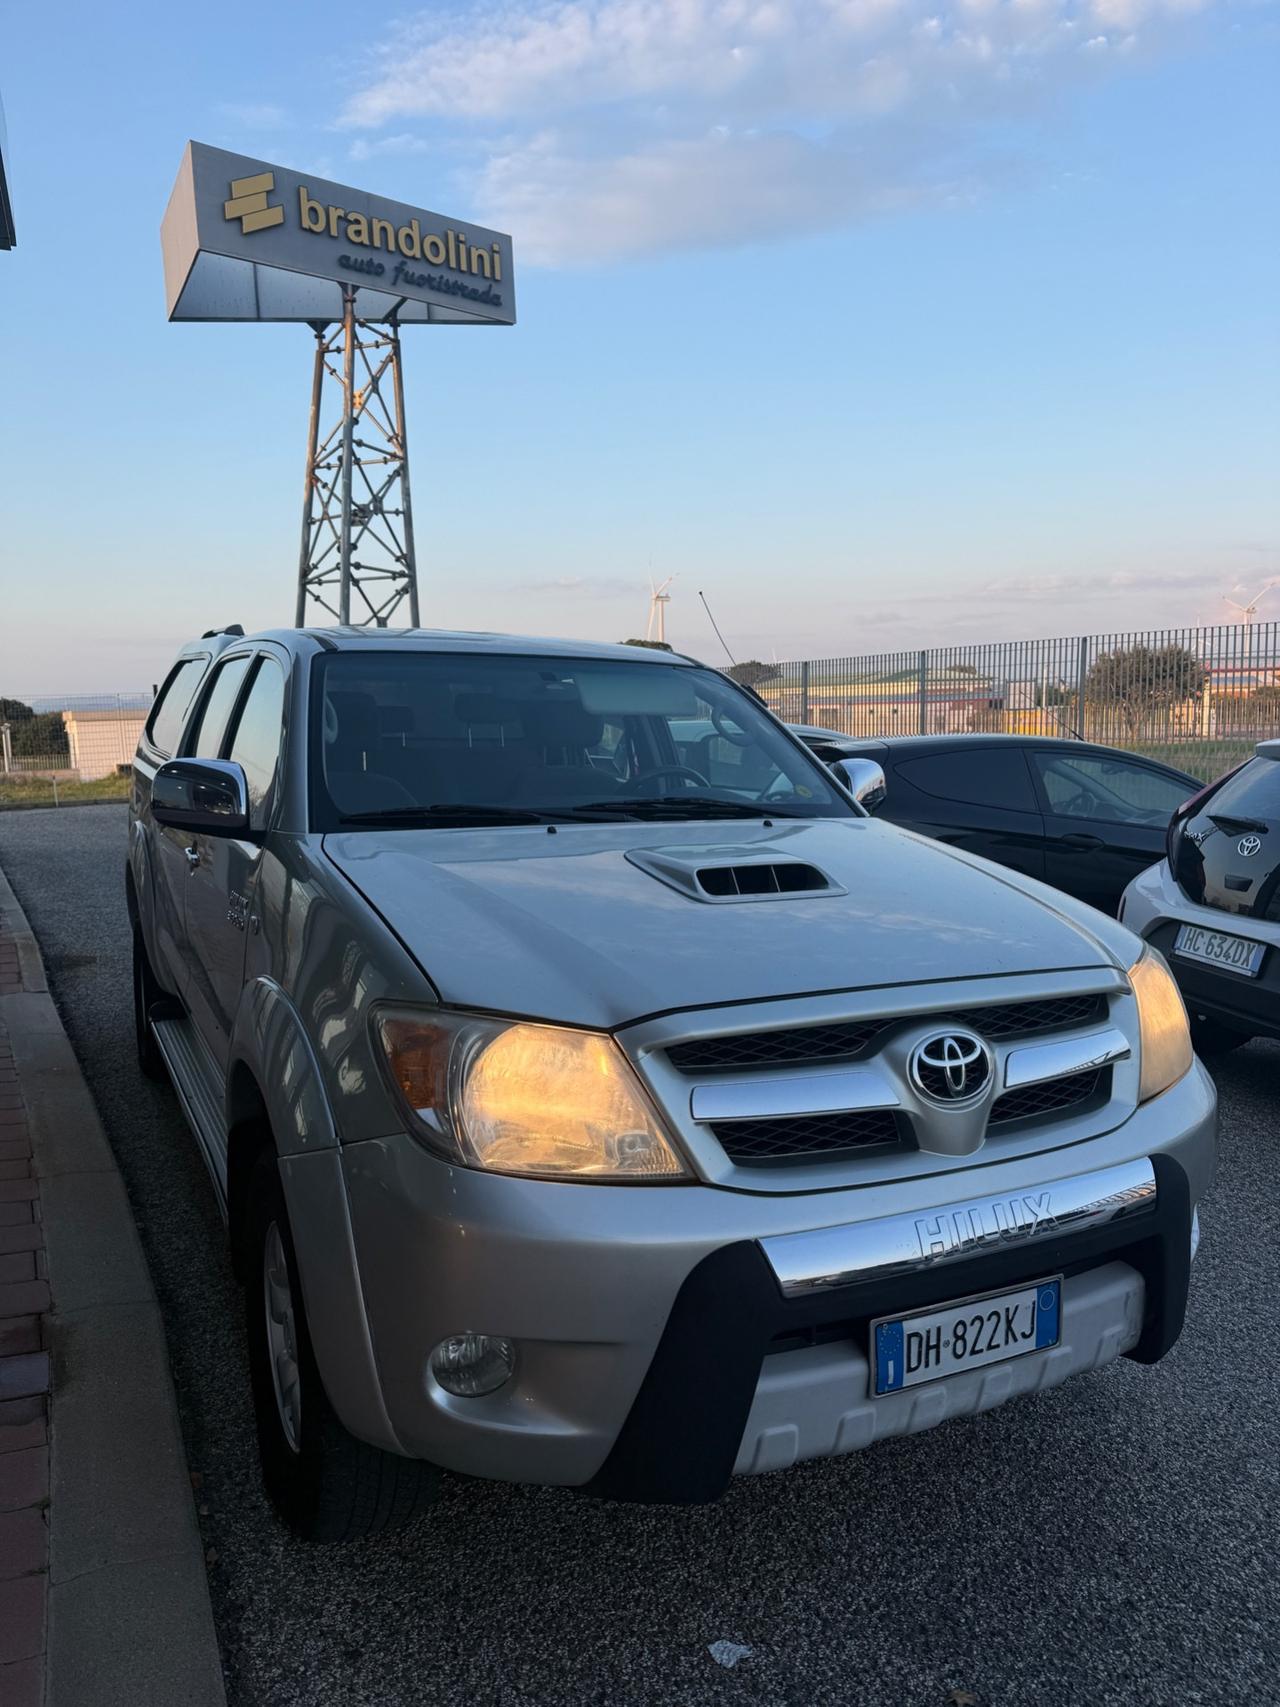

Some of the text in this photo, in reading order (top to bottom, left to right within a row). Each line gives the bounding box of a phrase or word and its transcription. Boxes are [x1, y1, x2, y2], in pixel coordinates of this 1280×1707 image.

[299, 186, 501, 281] brandolini
[338, 254, 503, 306] auto fuoristrada
[914, 1192, 1061, 1259] HILUX
